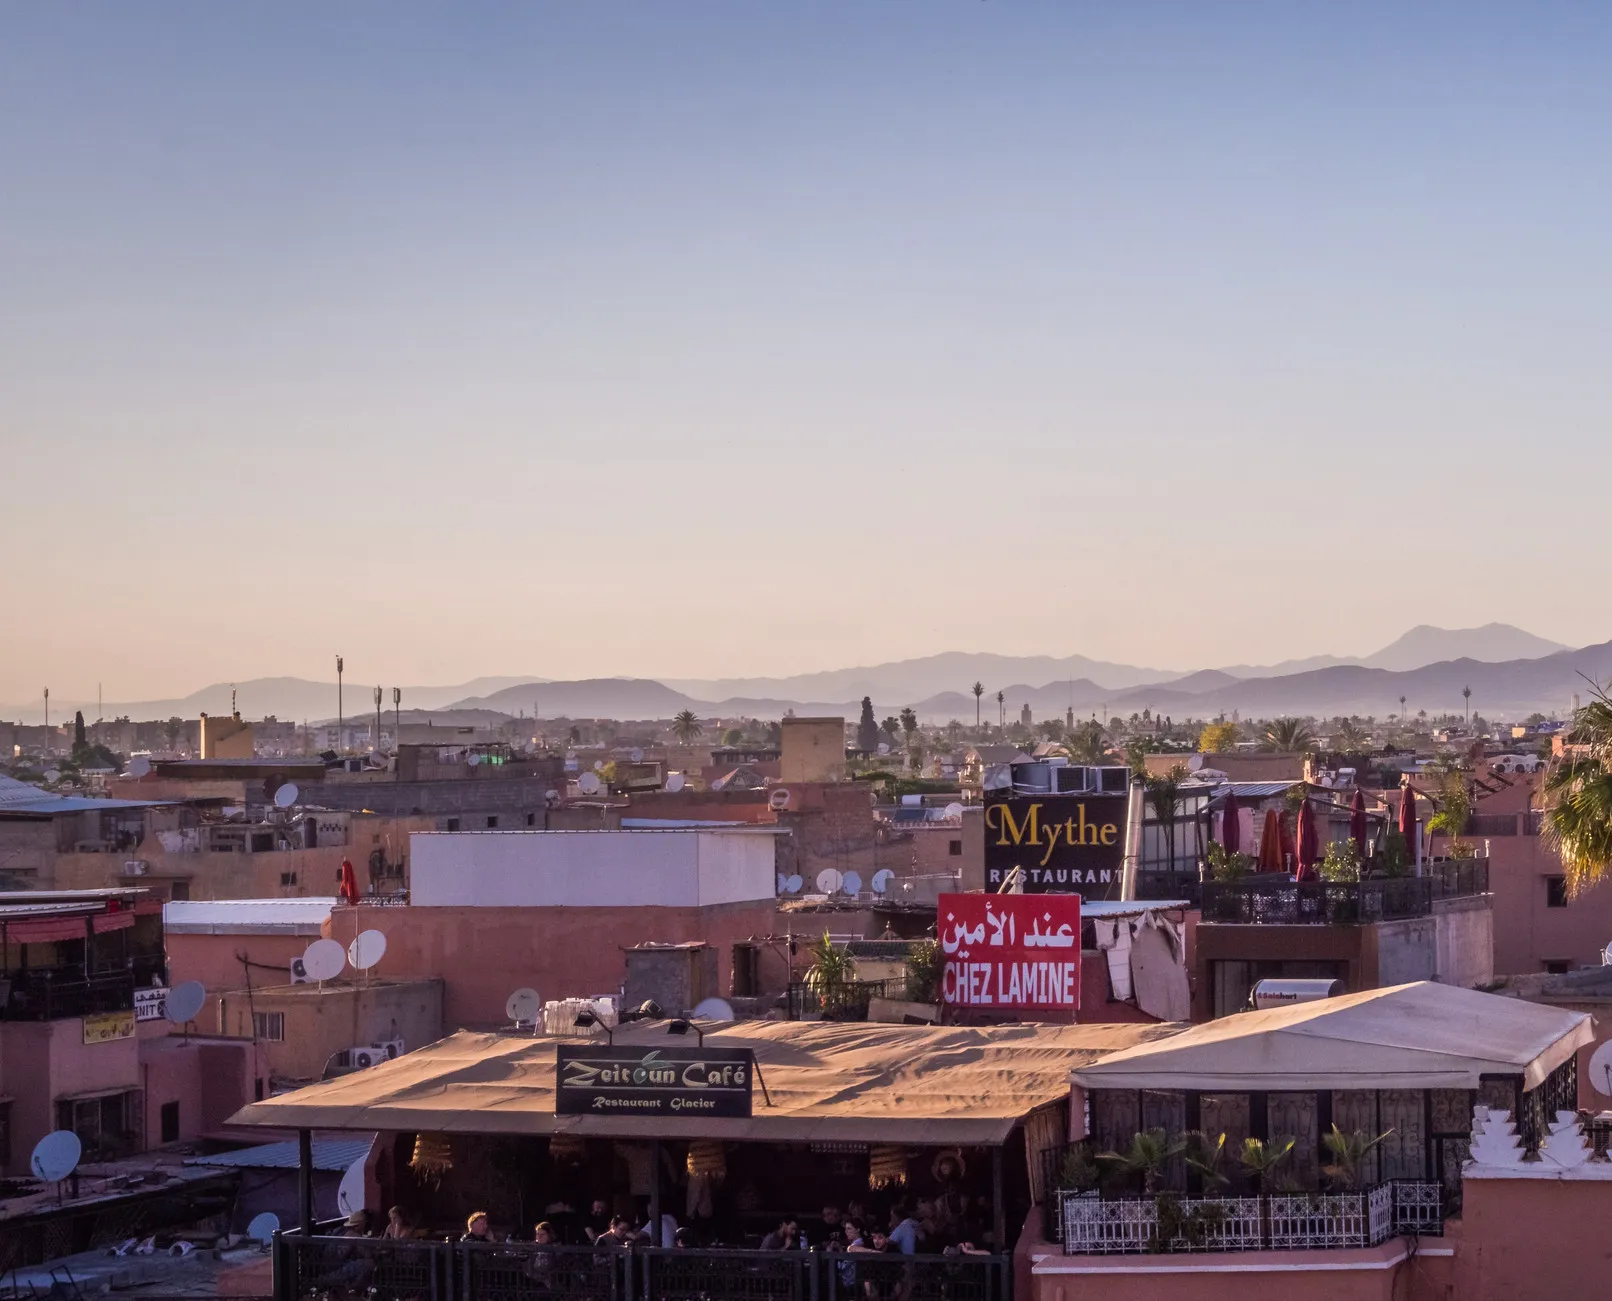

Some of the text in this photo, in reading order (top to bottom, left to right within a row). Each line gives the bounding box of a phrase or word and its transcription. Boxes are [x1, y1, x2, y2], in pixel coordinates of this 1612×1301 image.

[985, 803, 1118, 866] Mythe
[990, 869, 1123, 883] RESTAURANT
[942, 901, 1075, 959] عند الأمين
[942, 961, 1075, 1004] CHEZ LAMINE
[682, 1062, 746, 1088] Café
[592, 1096, 716, 1110] Restaurant Glacier
